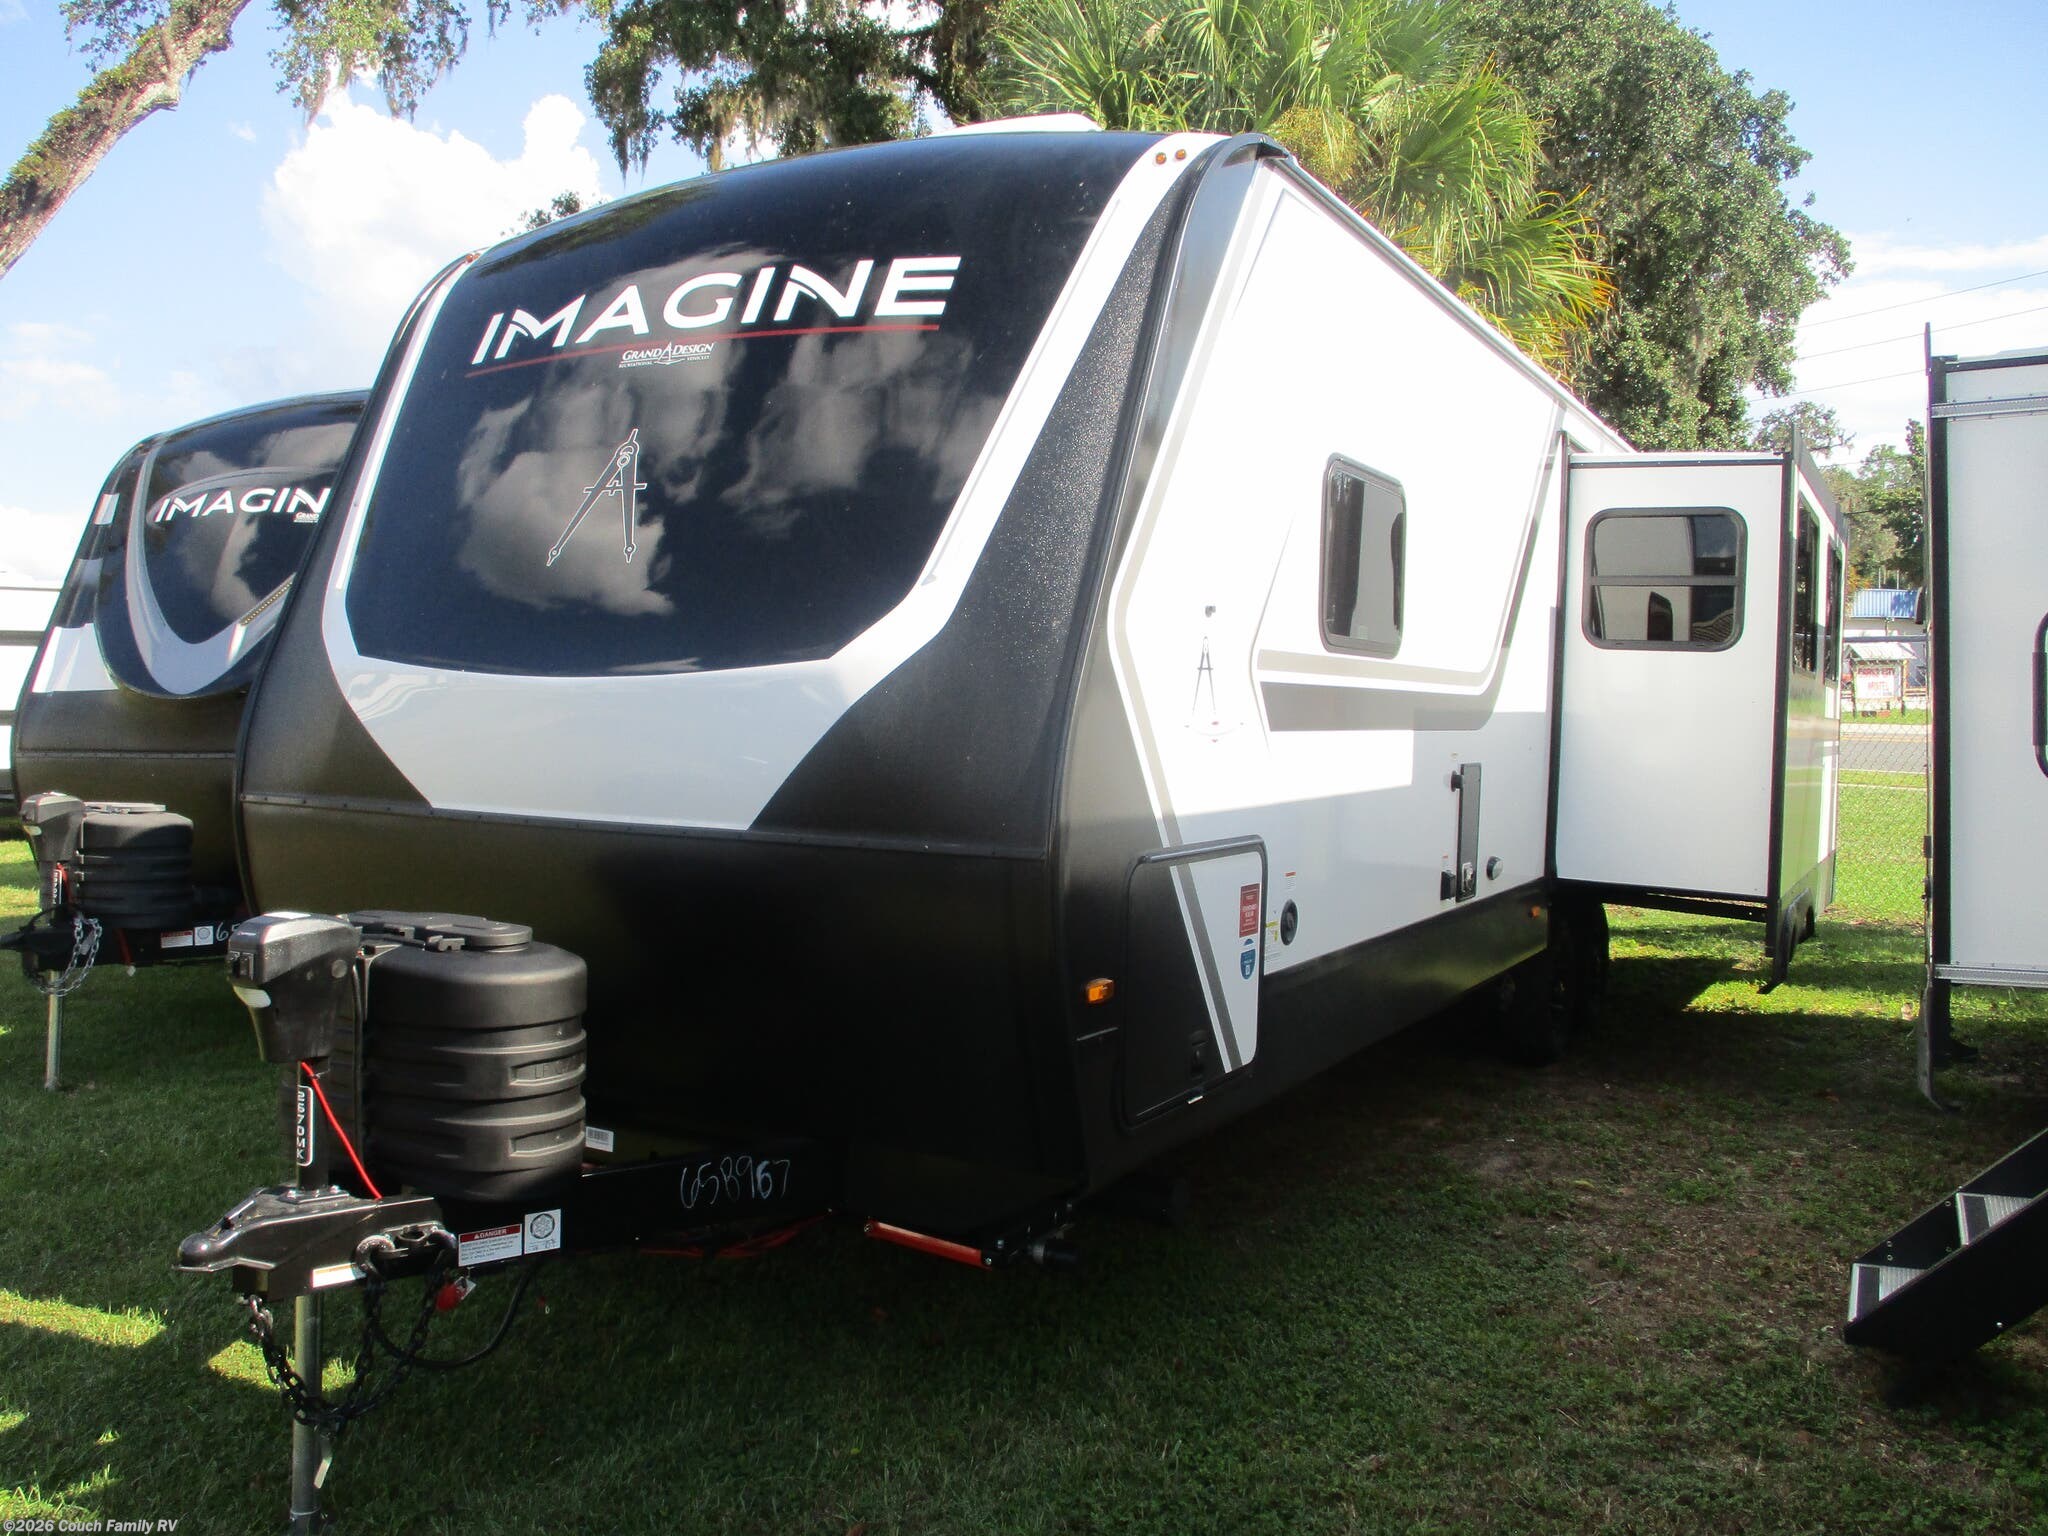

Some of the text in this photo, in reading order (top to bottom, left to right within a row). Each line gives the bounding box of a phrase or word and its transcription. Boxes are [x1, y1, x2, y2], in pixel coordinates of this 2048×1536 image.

[471, 256, 962, 365] IMAGINE
[622, 342, 714, 361] GRAND DESIGN
[154, 487, 331, 523] IMAGIN
[479, 1228, 507, 1239] DANGER
